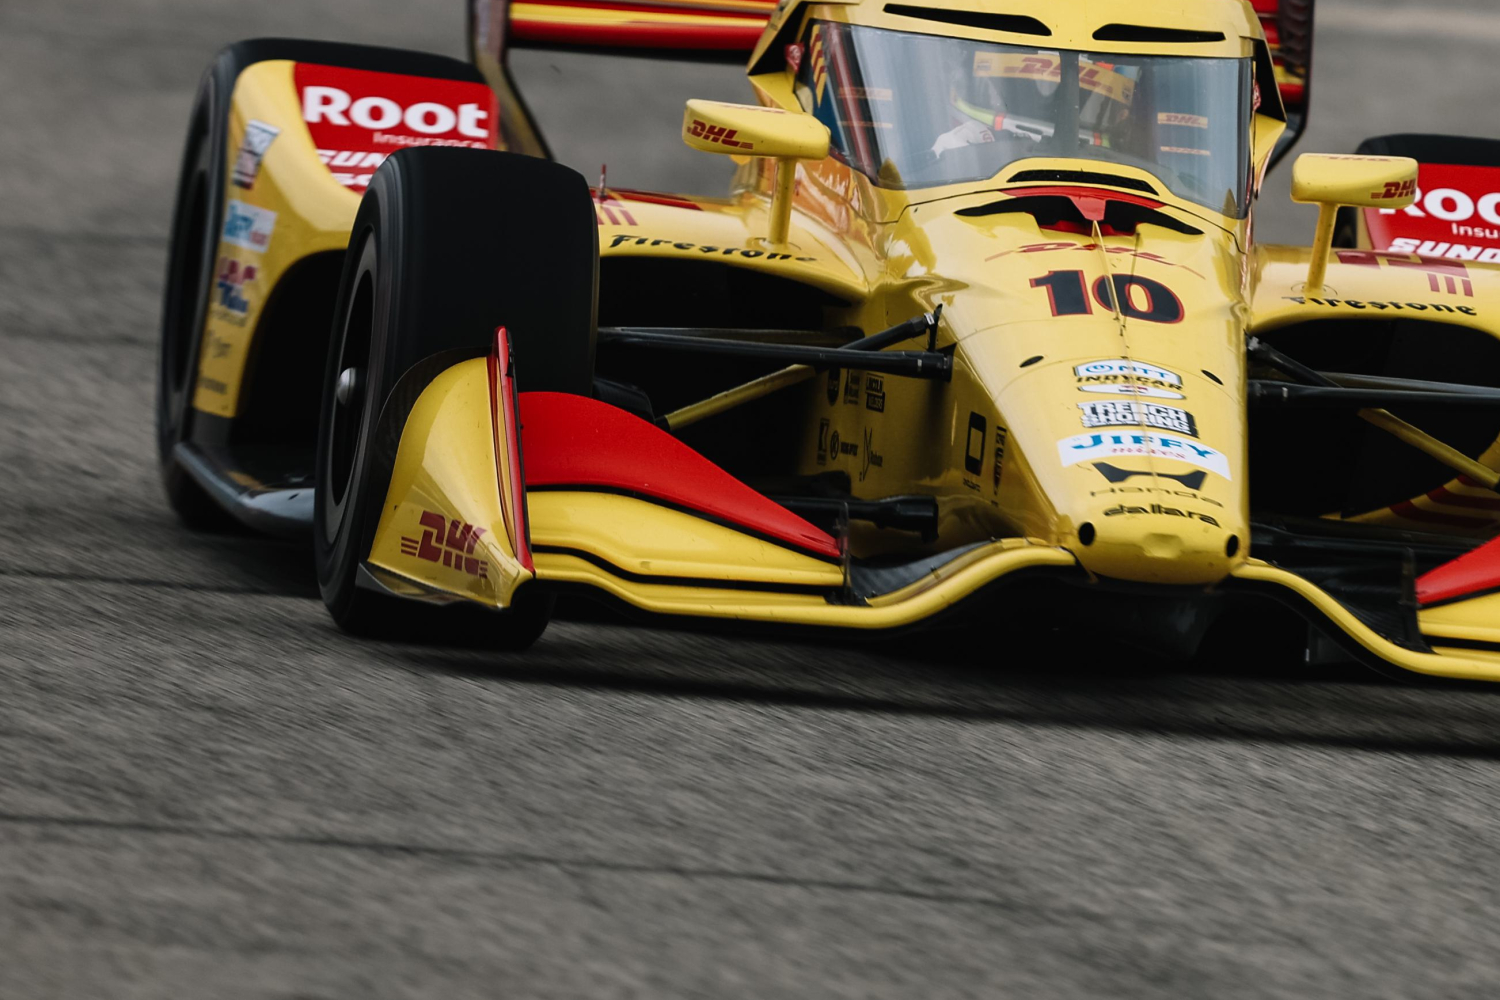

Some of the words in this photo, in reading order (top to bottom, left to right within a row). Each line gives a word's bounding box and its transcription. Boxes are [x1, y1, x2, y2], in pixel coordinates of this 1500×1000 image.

[304, 85, 489, 138] Root
[688, 119, 741, 147] DHL
[609, 234, 818, 262] Firestone
[1028, 269, 1185, 324] 10
[1281, 296, 1477, 316] Firestone
[1077, 374, 1183, 391] INDYCAR
[1118, 365, 1169, 378] NTT
[1072, 434, 1216, 459] JIFFY
[1103, 504, 1221, 528] dallara
[417, 510, 487, 576] DHL
